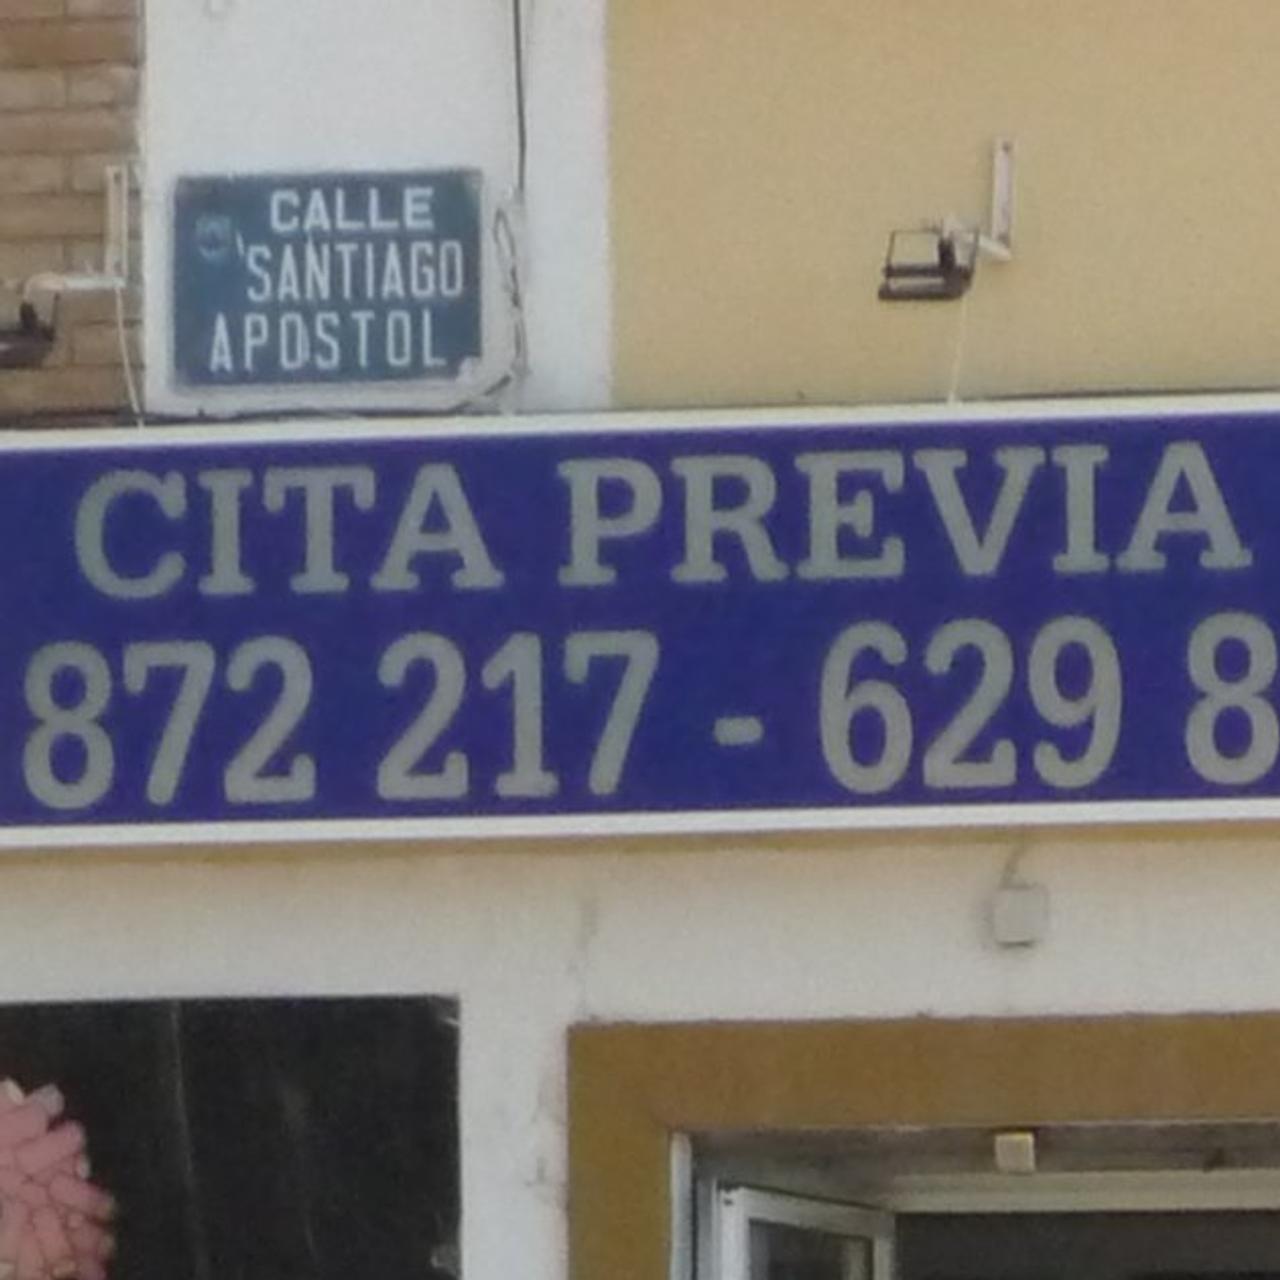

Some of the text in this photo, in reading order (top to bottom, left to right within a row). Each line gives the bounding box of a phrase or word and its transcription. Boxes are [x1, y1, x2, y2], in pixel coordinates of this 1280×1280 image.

[269, 187, 435, 233] CALLE
[245, 240, 464, 302] SANTIAGO
[208, 309, 448, 374] APOSTOL
[74, 440, 1253, 599] CITA PREVIA
[22, 638, 317, 810] 872
[376, 630, 660, 801] 217
[819, 614, 1123, 795] 629
